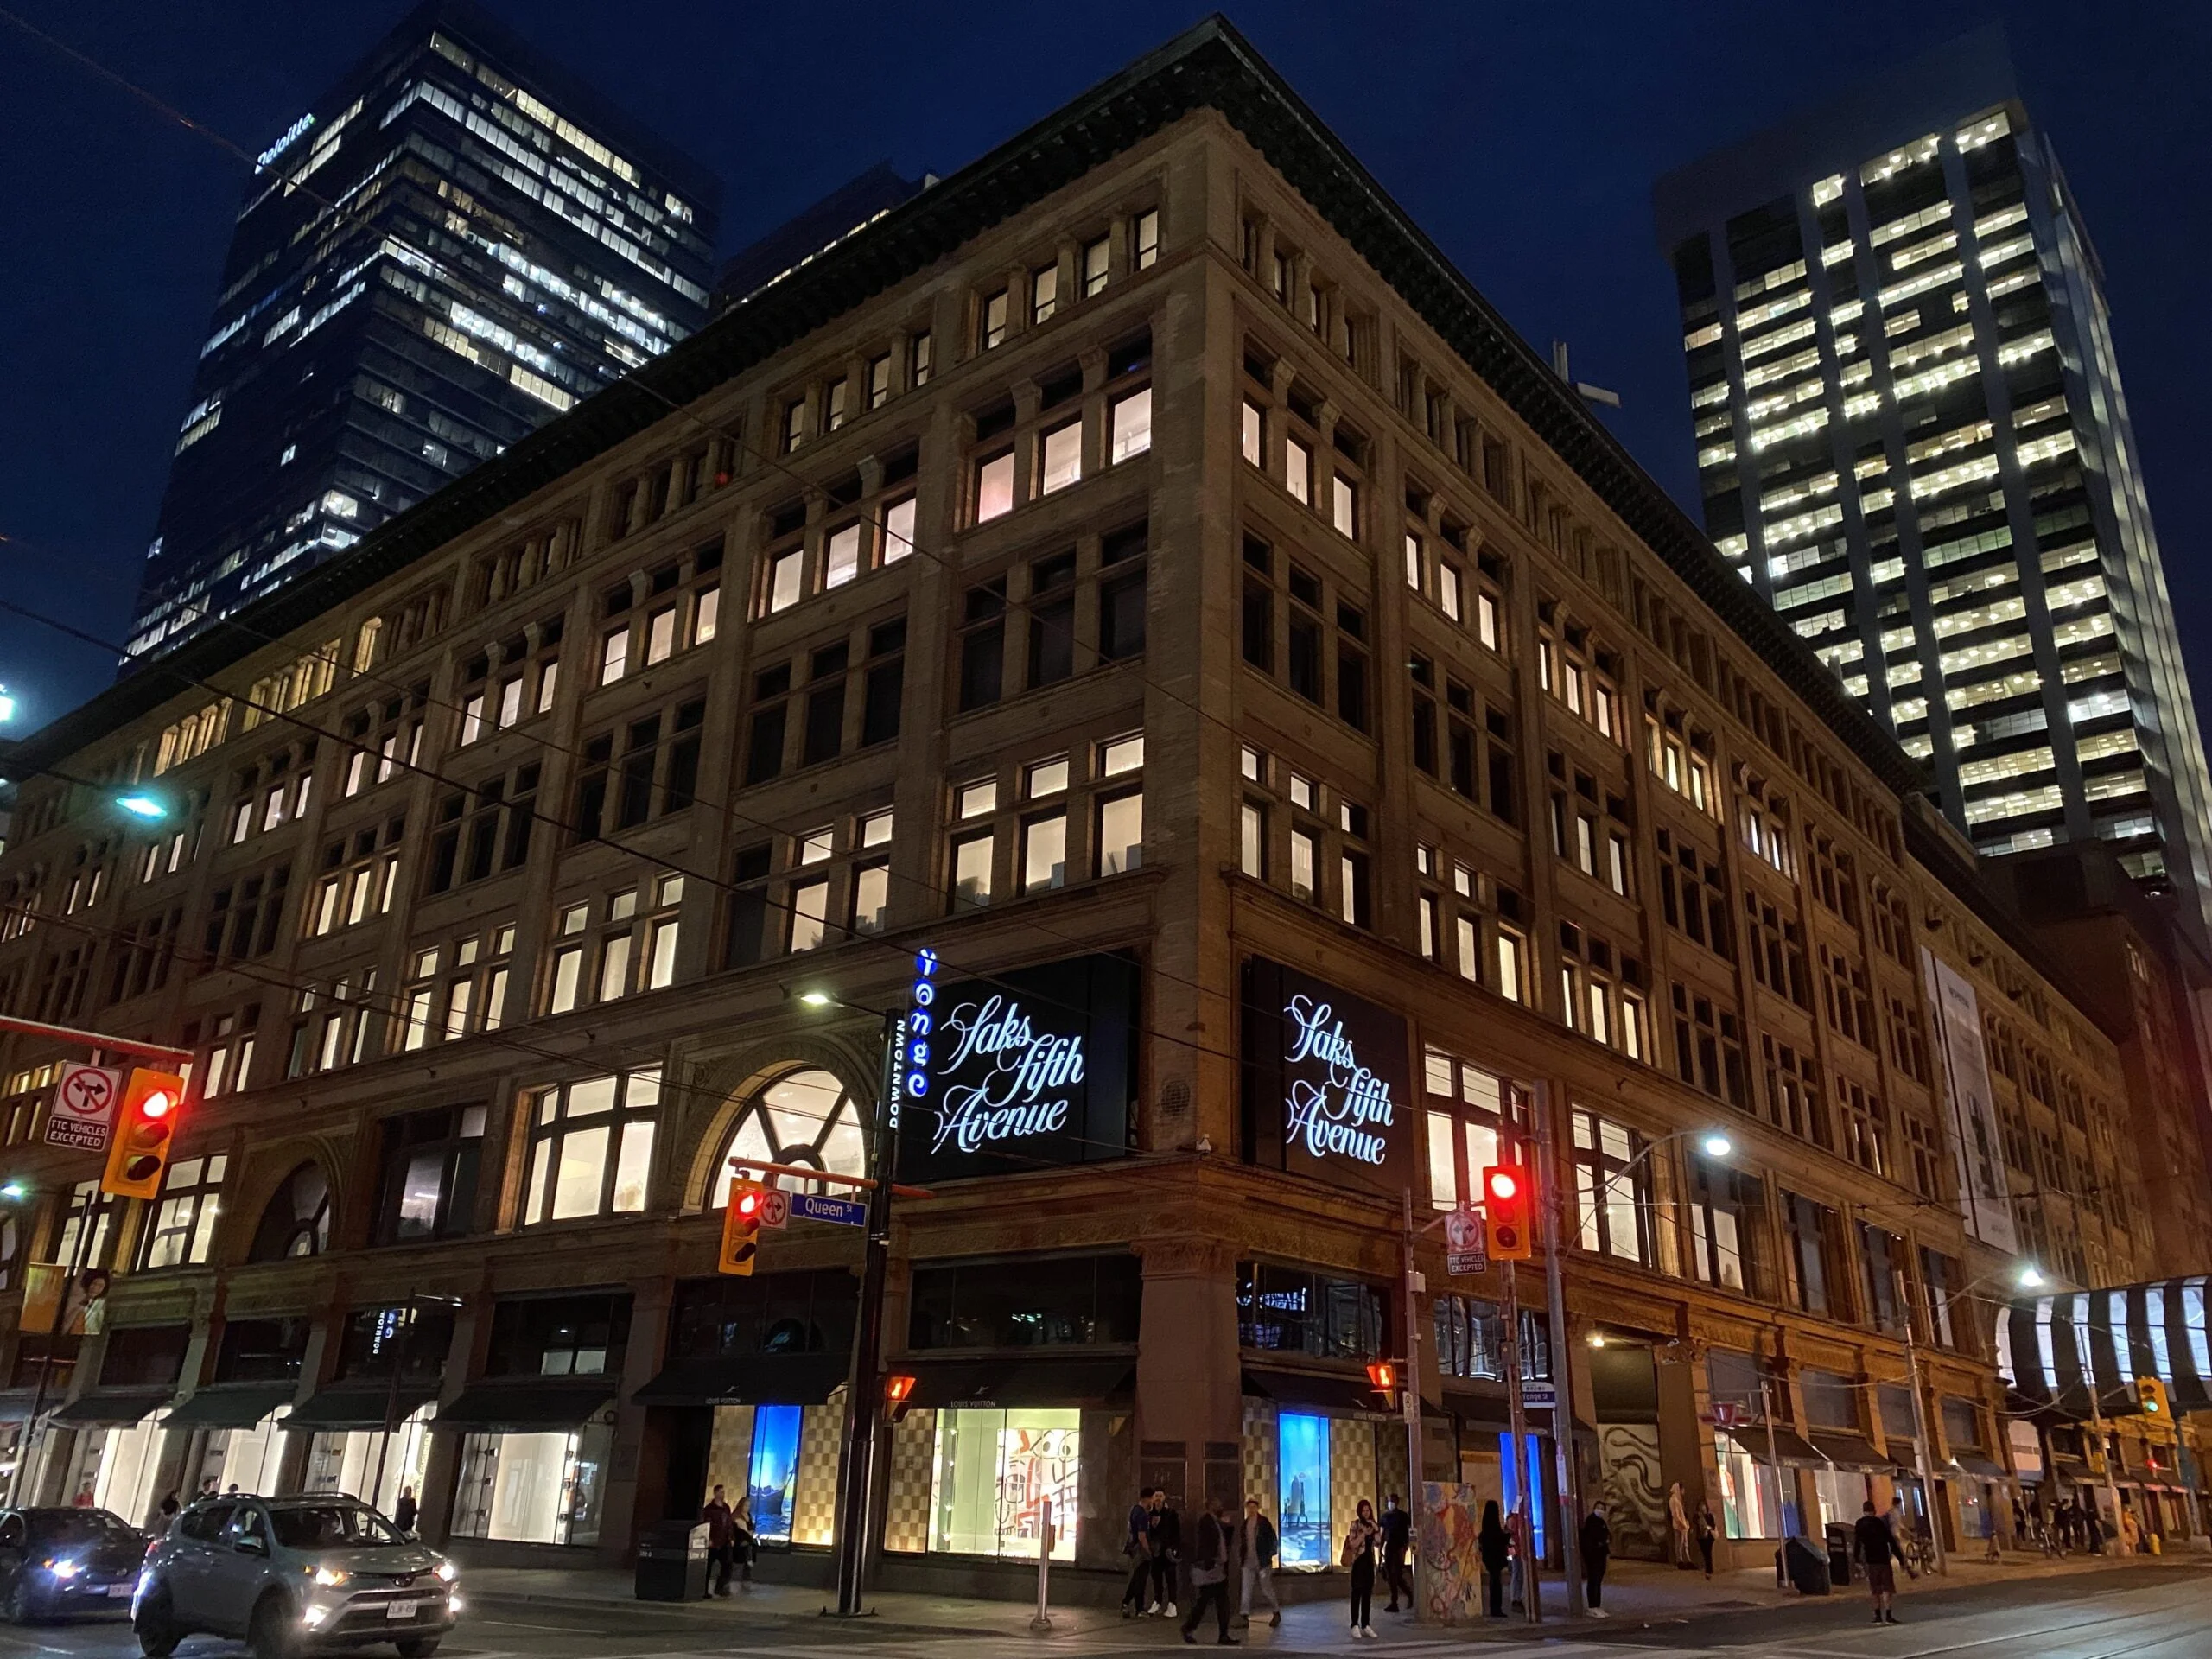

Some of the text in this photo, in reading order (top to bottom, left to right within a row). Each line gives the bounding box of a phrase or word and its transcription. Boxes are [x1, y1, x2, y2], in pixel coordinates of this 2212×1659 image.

[937, 995, 1033, 1075] Saks
[1284, 995, 1356, 1085] Saks
[889, 1019, 906, 1128] DOWNTOWN
[983, 1033, 1084, 1108] Fifth
[50, 1130, 101, 1147] EXCEPTED
[51, 1119, 105, 1137] TTC VEHICLES
[931, 1085, 1069, 1154] Avenue
[1285, 1080, 1386, 1165] Avenue
[805, 1198, 853, 1217] Queen St
[1452, 1263, 1484, 1273] EXCEPTED
[950, 1400, 996, 1408] LOUIS VUITTON
